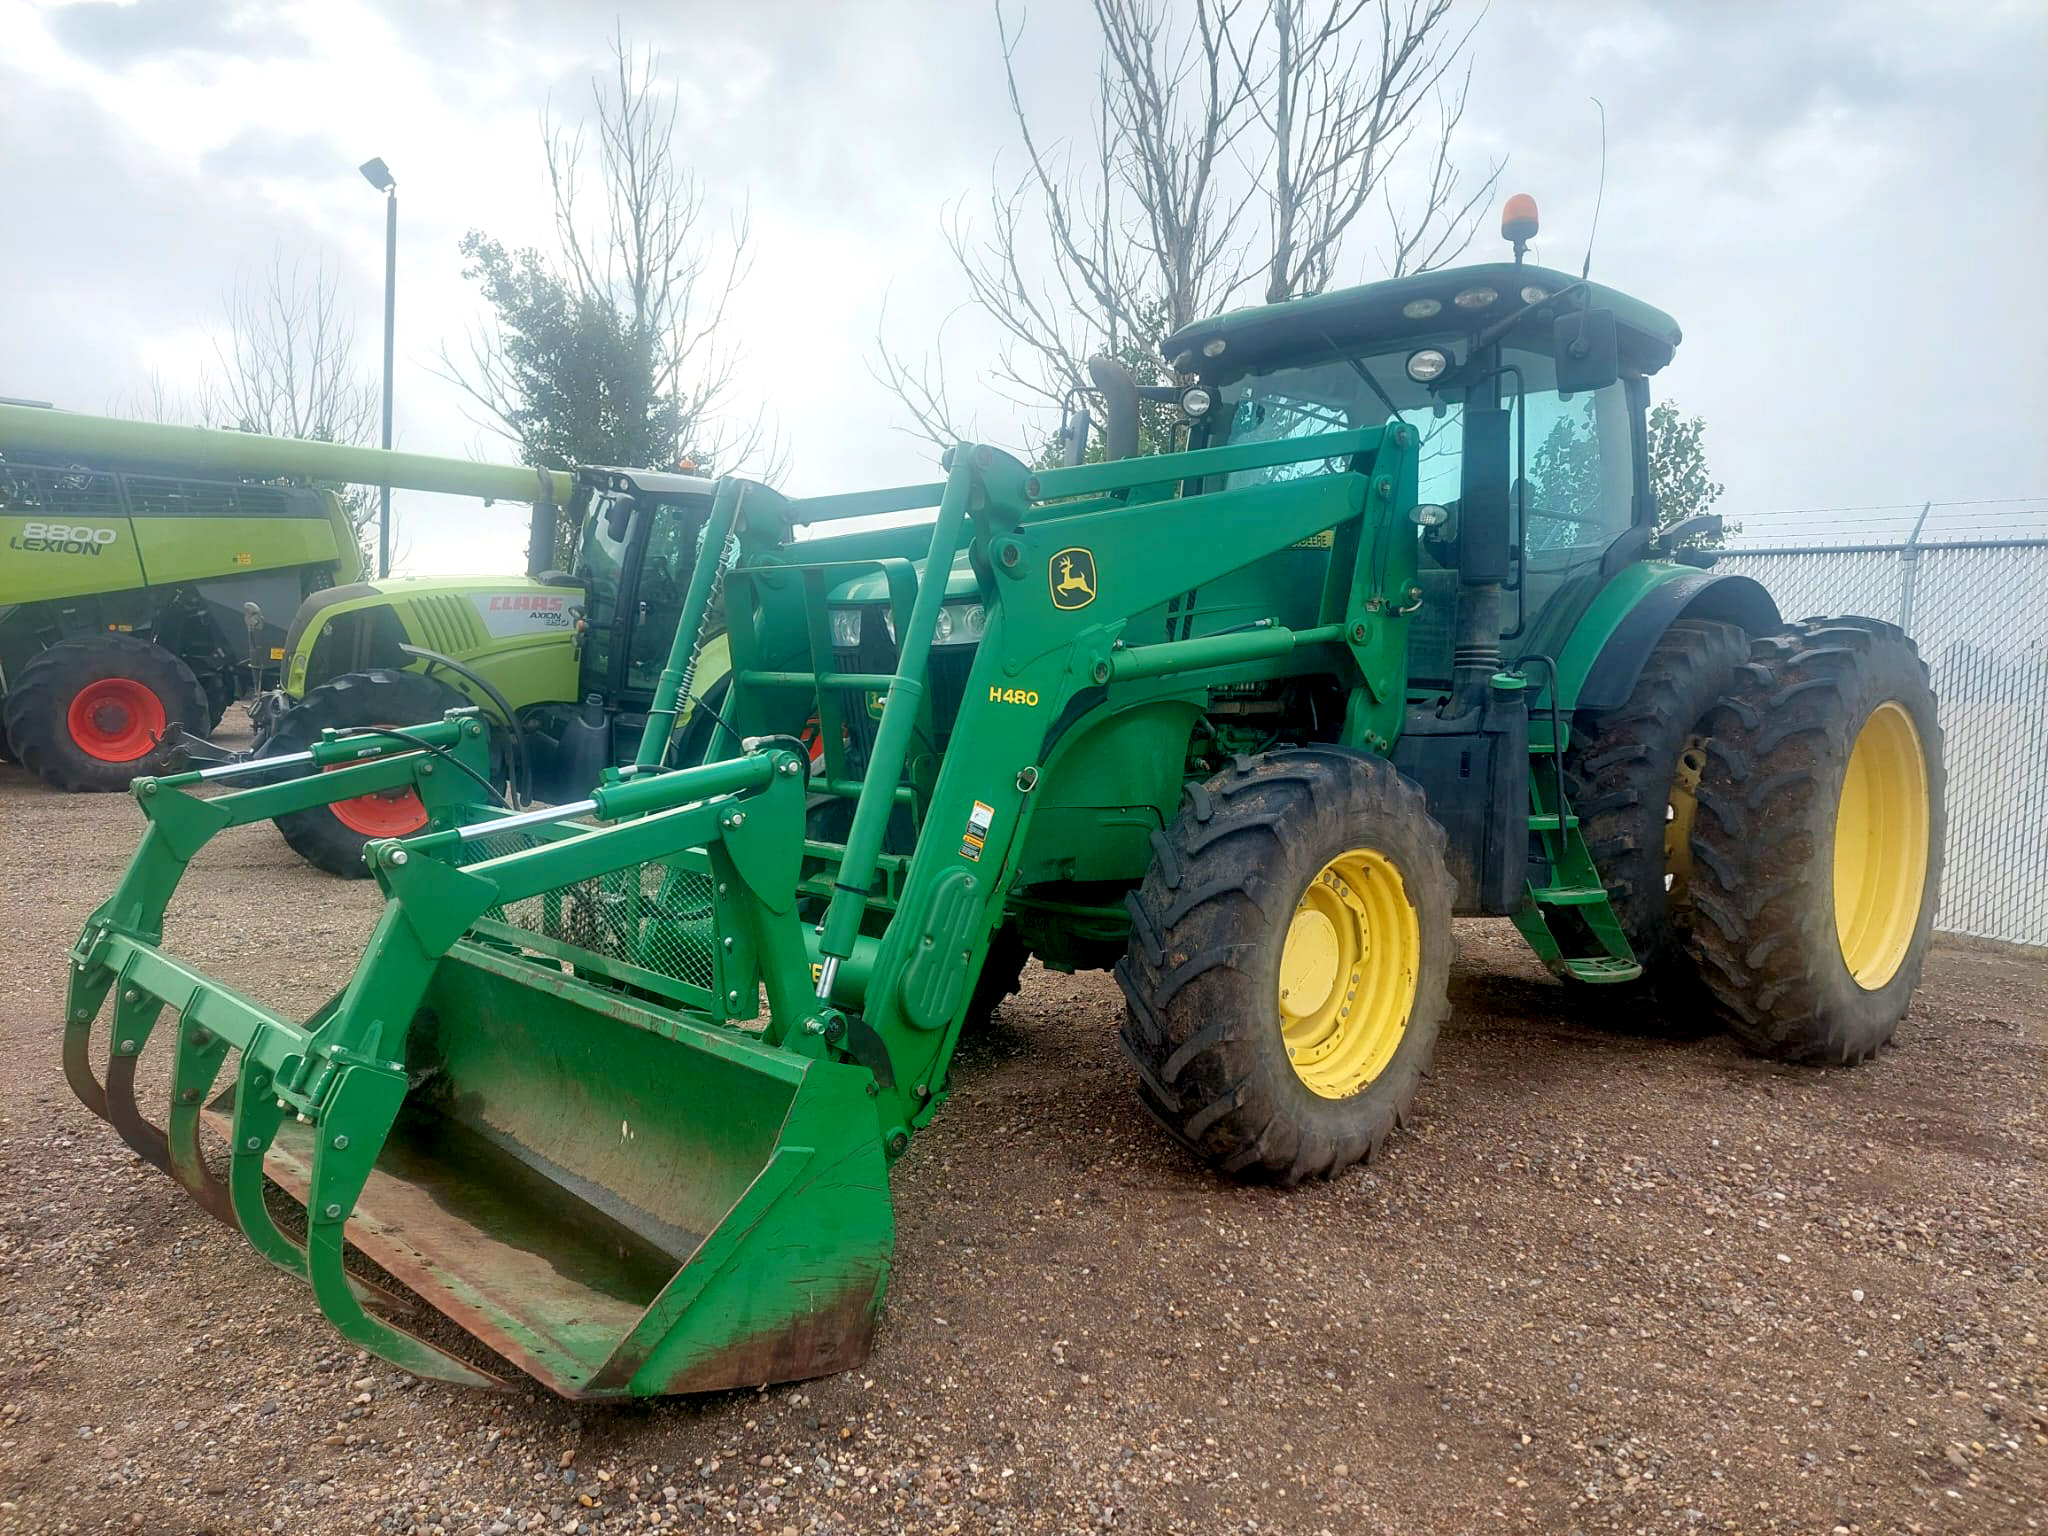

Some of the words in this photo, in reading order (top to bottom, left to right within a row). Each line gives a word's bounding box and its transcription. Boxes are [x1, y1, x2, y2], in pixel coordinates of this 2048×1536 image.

[24, 522, 117, 544] 8800
[10, 536, 103, 555] LEXION
[489, 596, 563, 611] CLAAS
[529, 611, 562, 620] AXION
[989, 686, 1039, 706] H480
